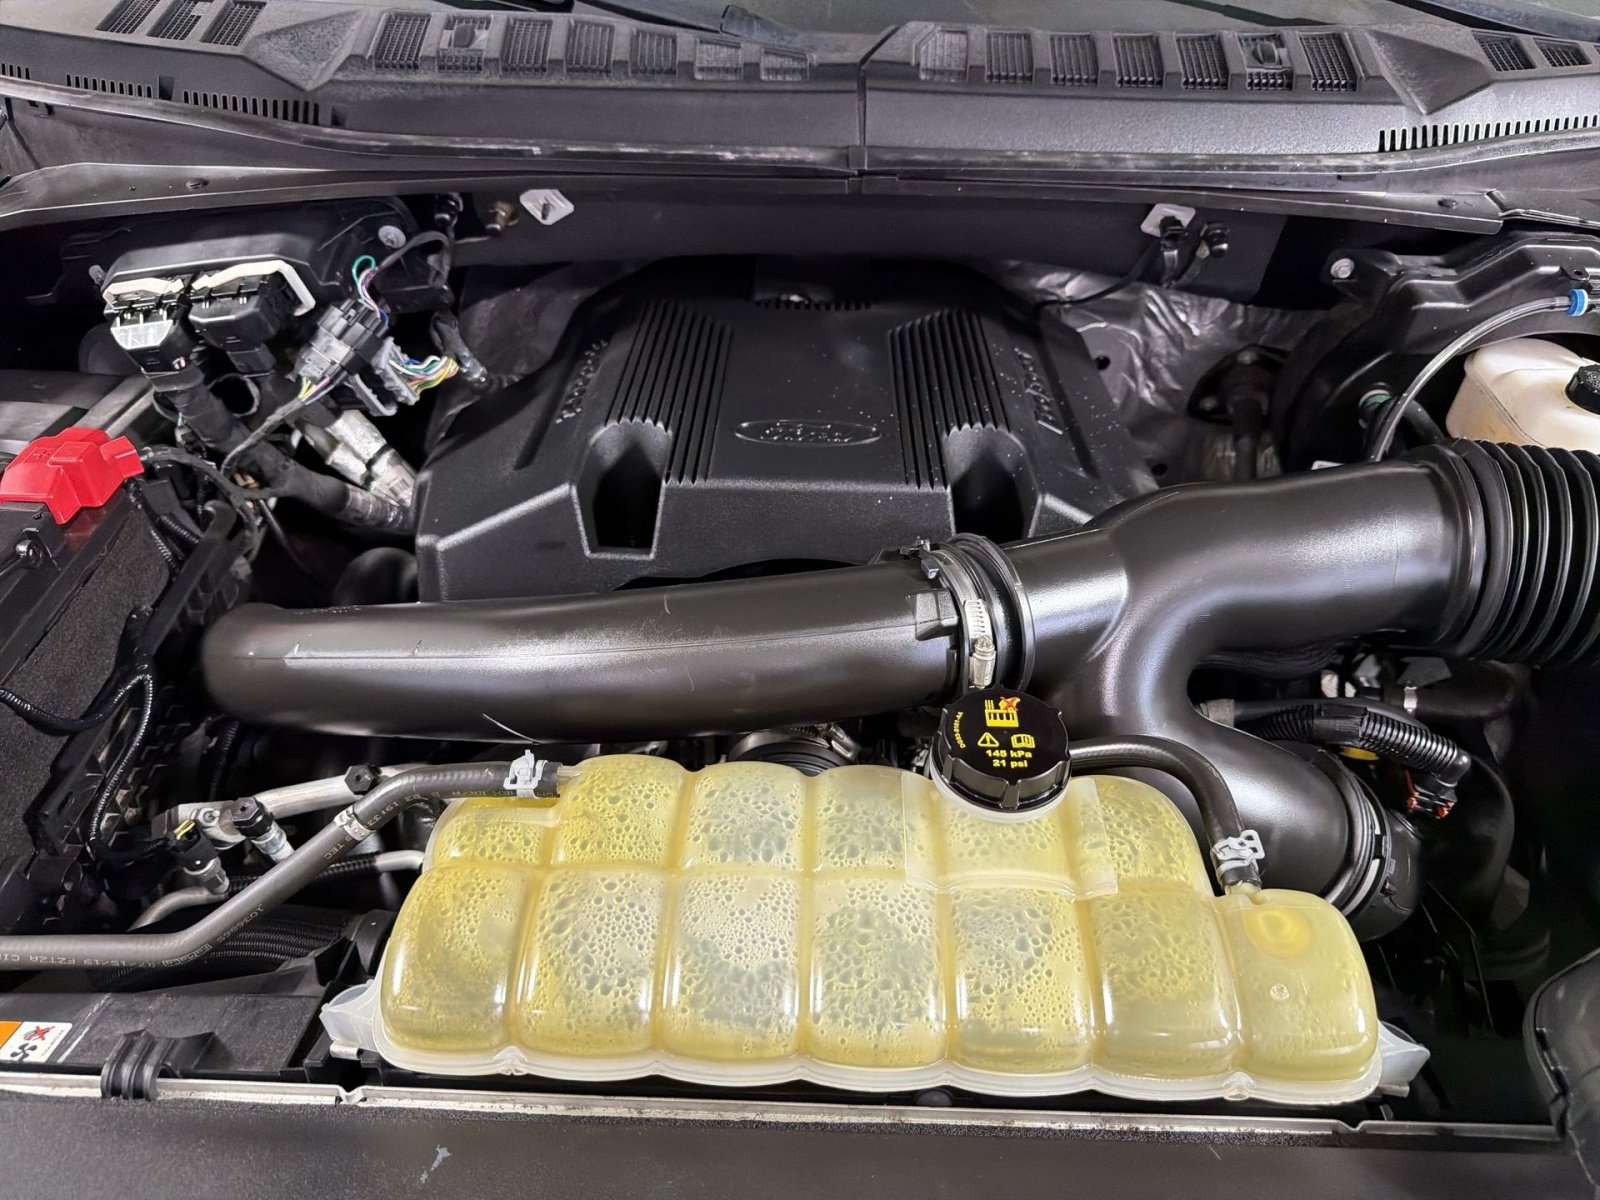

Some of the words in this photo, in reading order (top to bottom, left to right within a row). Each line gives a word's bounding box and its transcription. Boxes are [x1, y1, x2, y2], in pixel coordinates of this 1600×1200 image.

[986, 749, 1007, 758] 145
[1010, 749, 1032, 758] kPa
[992, 759, 1006, 767] 21
[1010, 759, 1028, 768] psi
